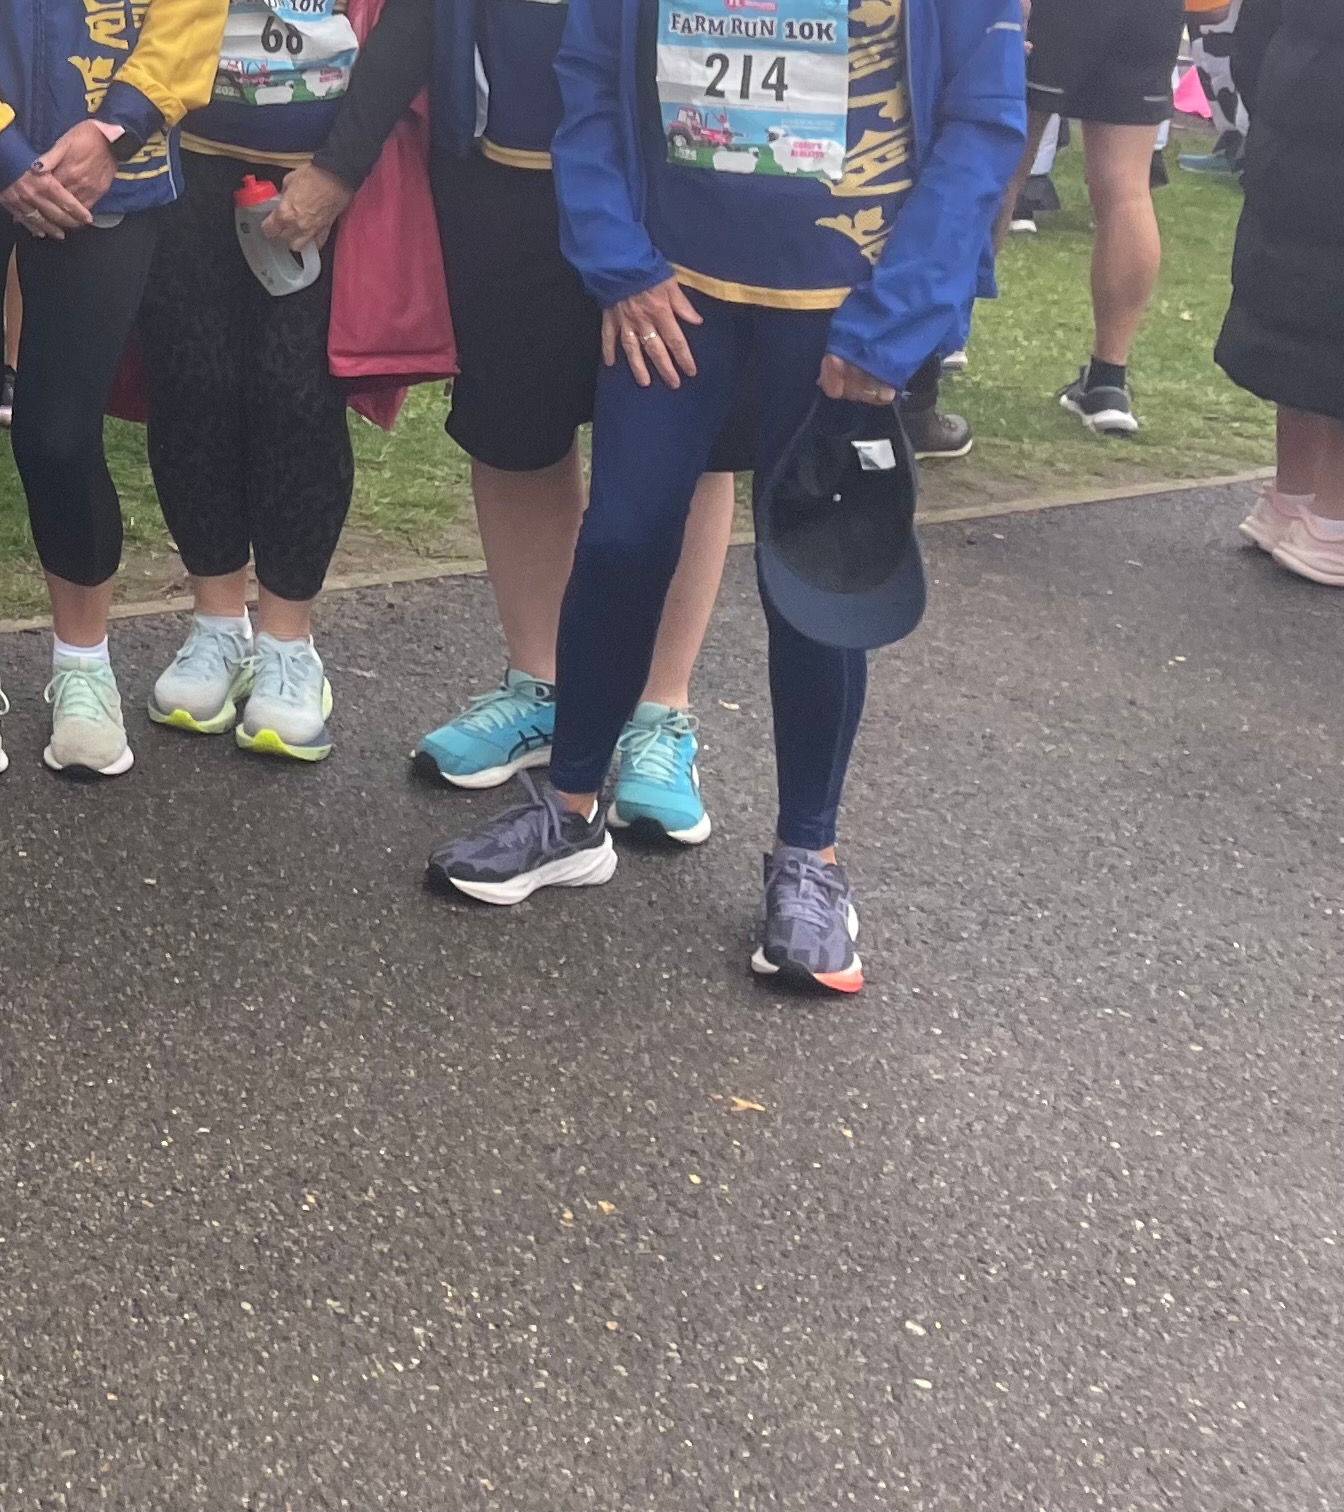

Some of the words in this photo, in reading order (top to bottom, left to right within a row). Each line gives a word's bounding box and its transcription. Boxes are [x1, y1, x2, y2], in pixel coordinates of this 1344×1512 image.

[671, 13, 725, 35] FARM
[731, 16, 774, 37] RUN
[785, 21, 834, 41] 10K
[704, 52, 788, 102] 214
